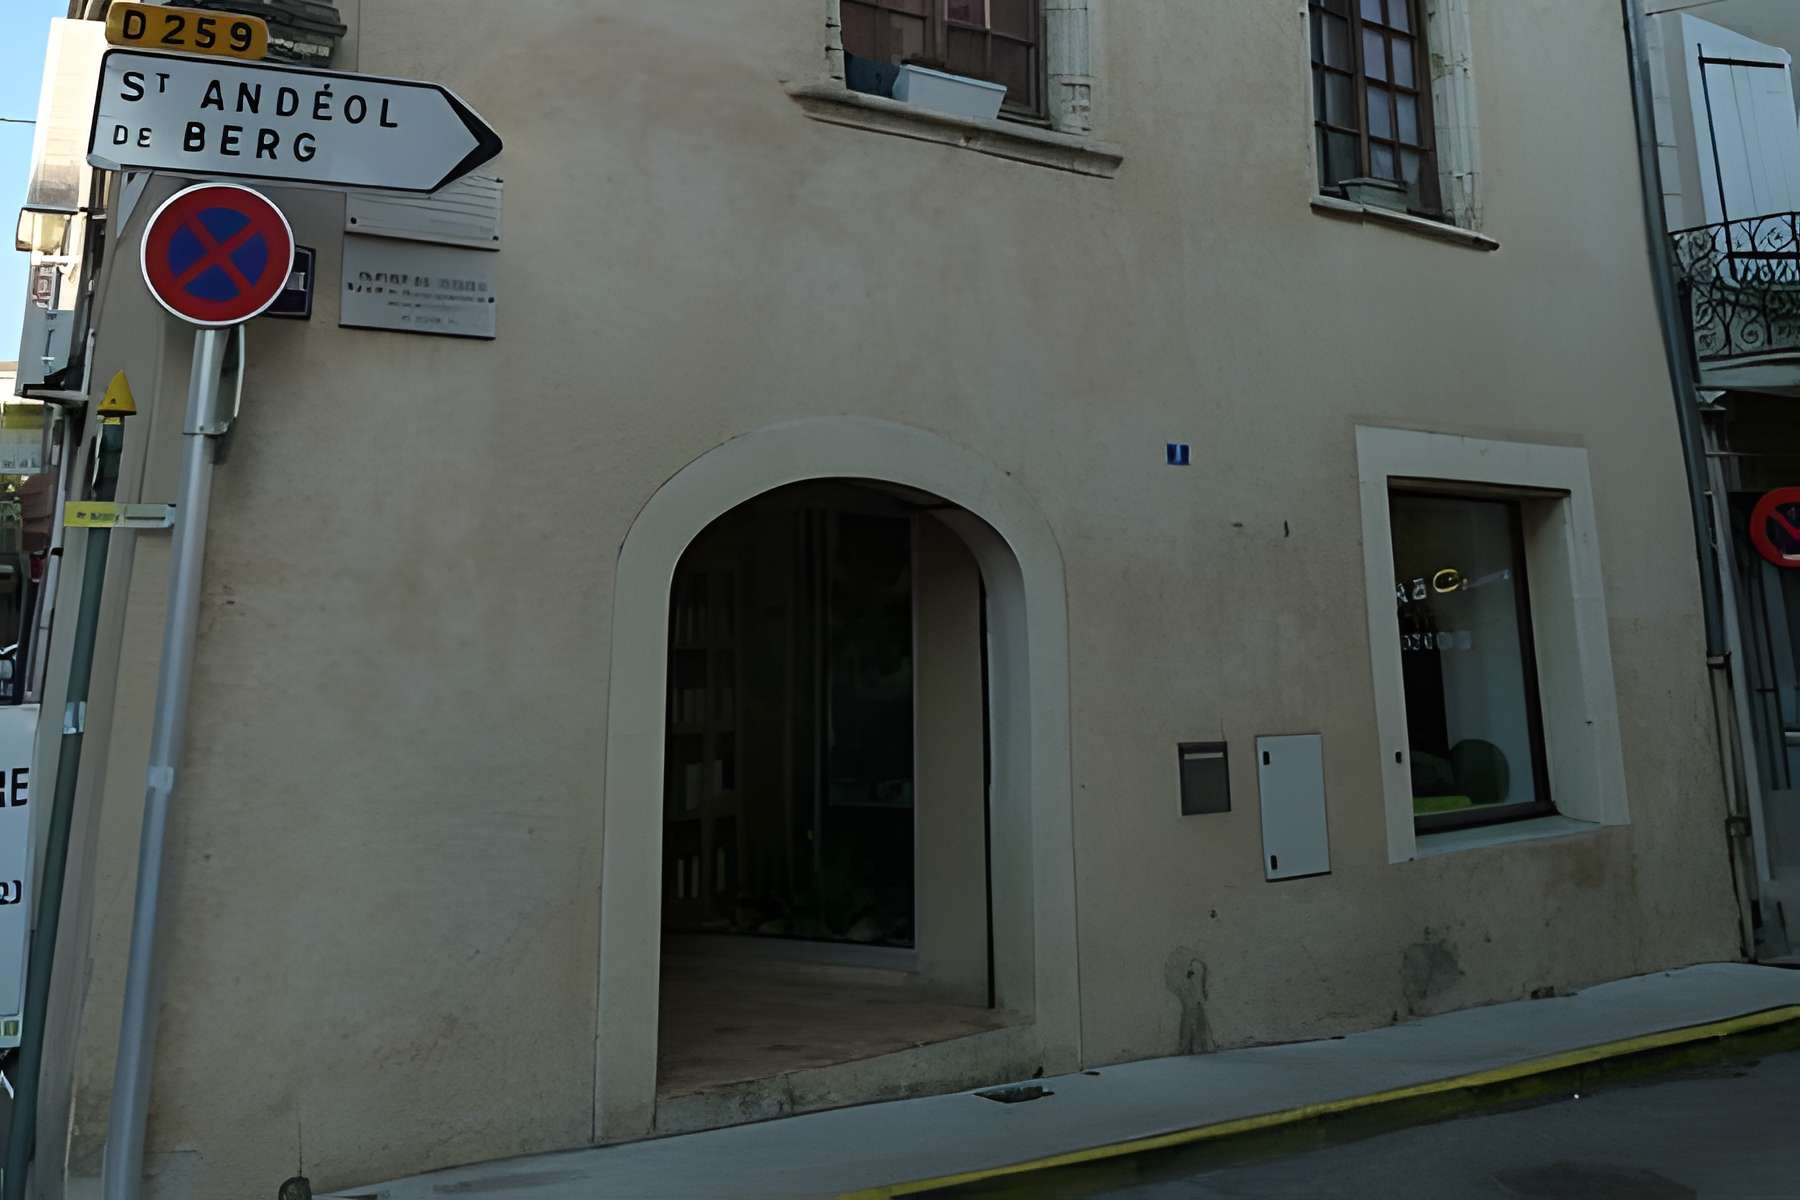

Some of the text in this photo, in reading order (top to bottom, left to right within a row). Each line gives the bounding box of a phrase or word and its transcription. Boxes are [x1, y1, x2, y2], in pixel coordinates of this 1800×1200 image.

[122, 9, 253, 52] D 259
[200, 79, 398, 128] ANDÉOL
[113, 121, 317, 162] DE BERG
